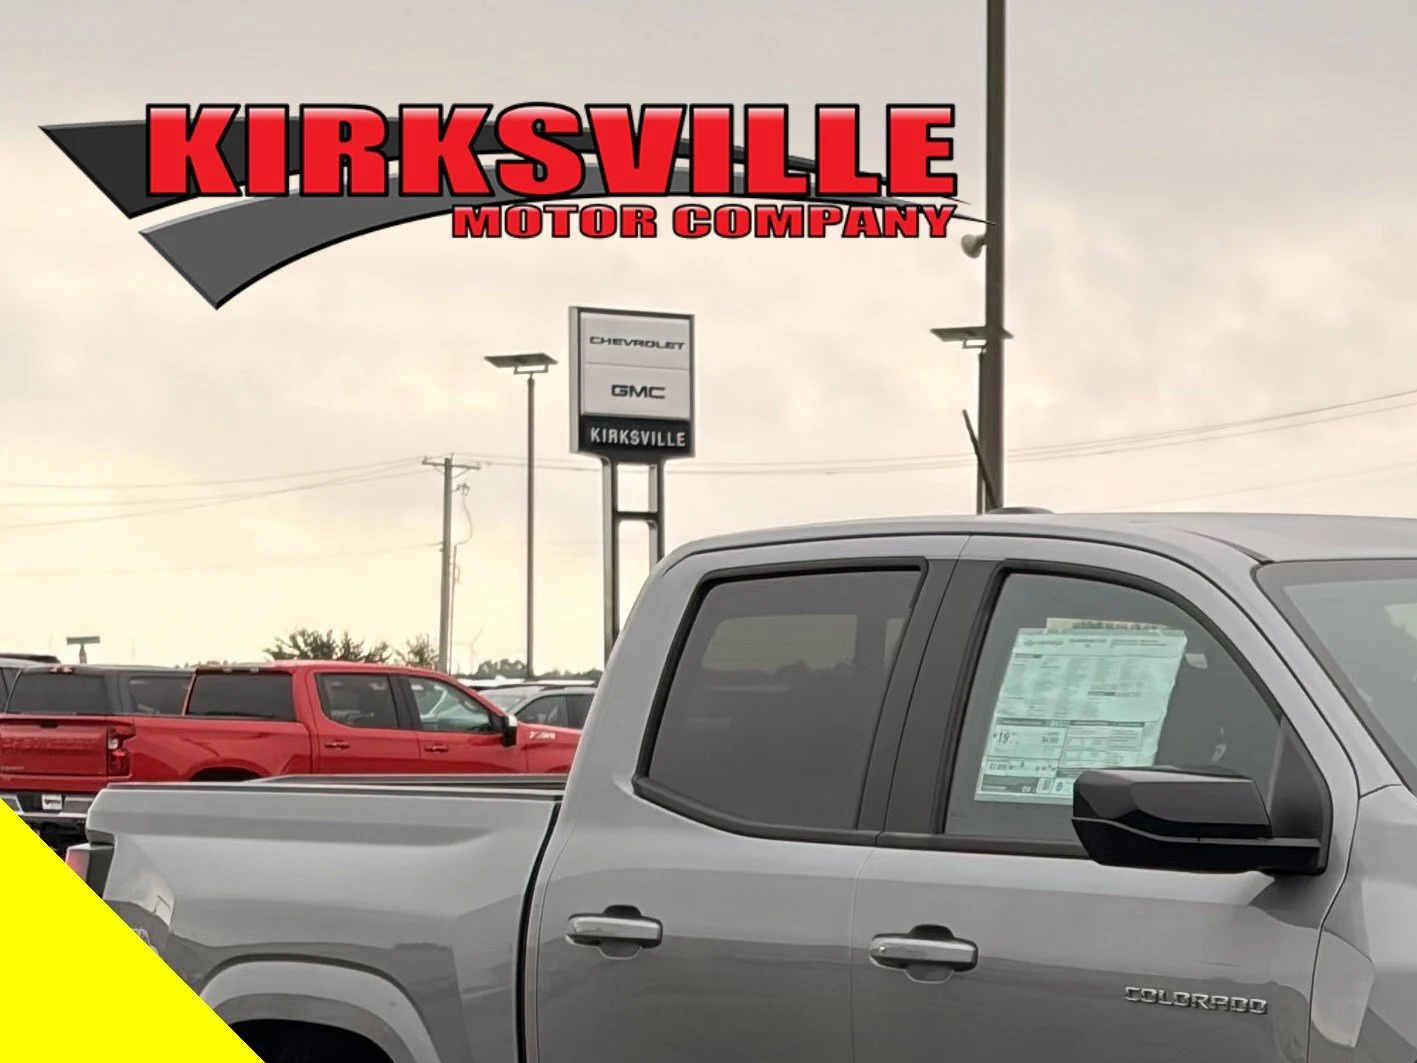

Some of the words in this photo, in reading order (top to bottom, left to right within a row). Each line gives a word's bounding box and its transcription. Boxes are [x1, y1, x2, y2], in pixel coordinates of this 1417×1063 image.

[589, 336, 685, 350] CHEVROLET
[611, 384, 666, 399] GMC
[590, 427, 686, 447] KIRKSVILLE
[1125, 986, 1268, 1014] COLORADO
